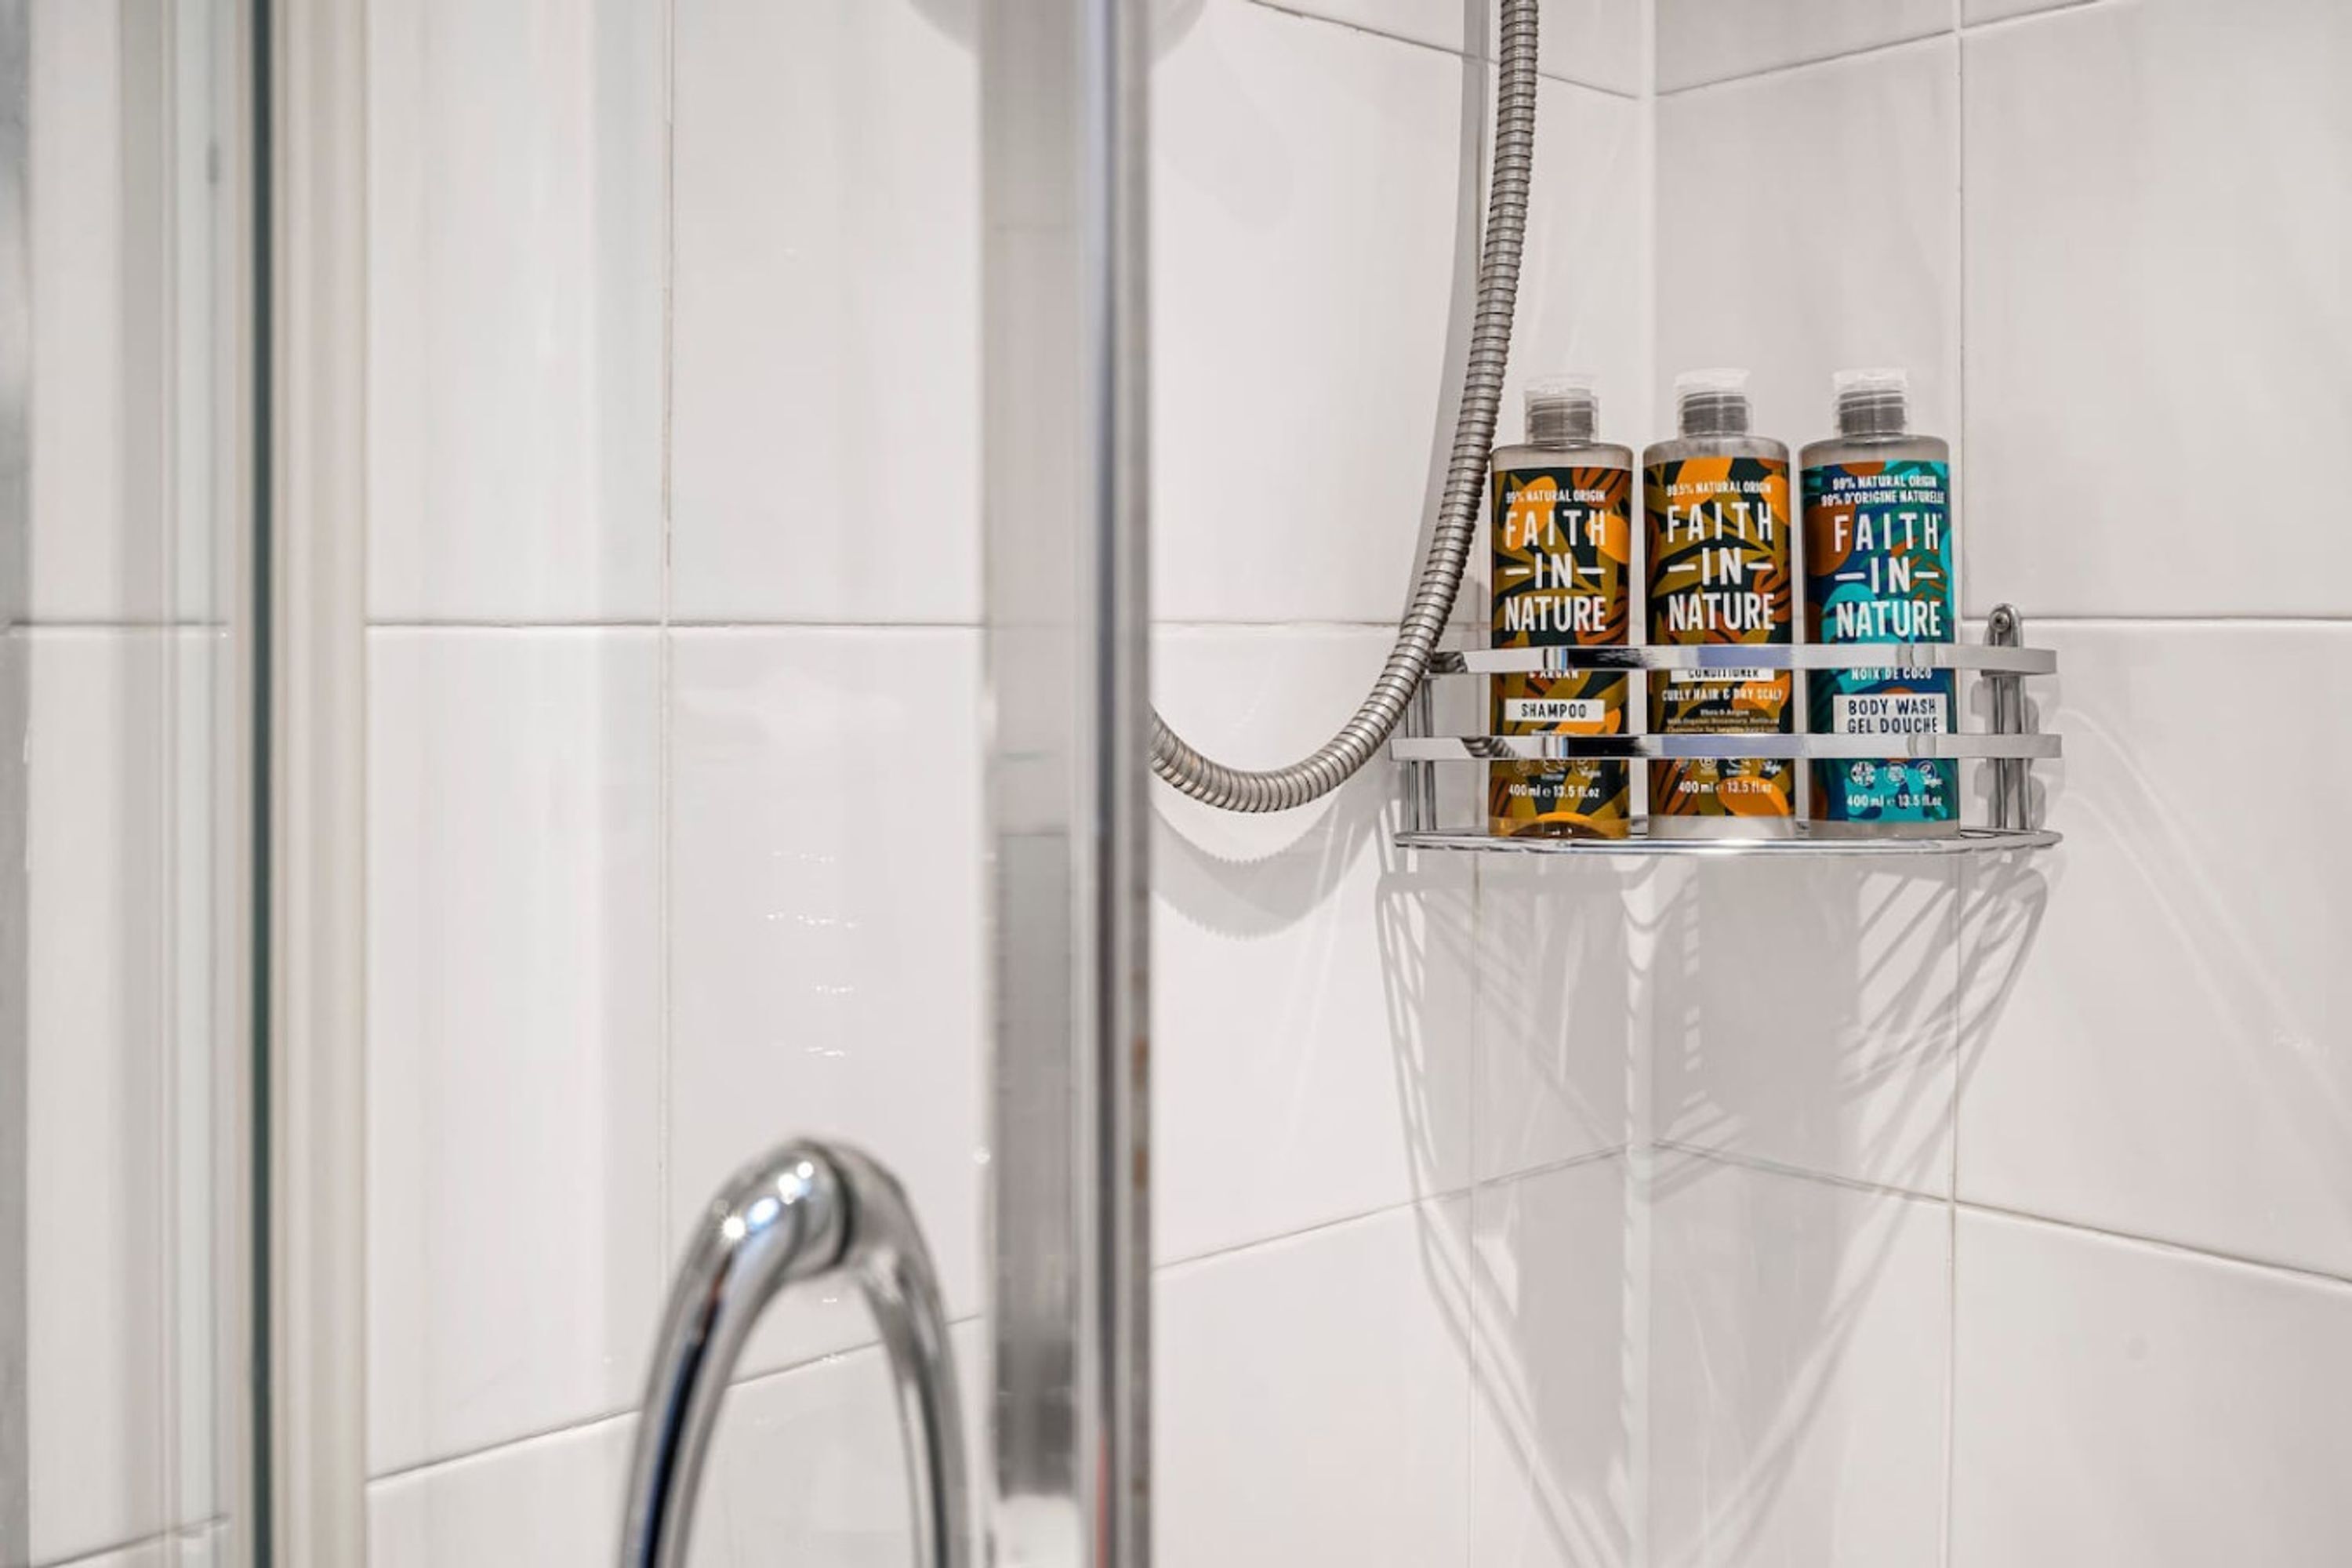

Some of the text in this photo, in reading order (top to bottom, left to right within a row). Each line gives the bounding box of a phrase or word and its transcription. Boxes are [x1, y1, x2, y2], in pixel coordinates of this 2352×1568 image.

[1695, 481, 1742, 495] NATURAL
[1743, 480, 1773, 494] ORIGIN
[1857, 475, 1907, 488] NATURAL
[1908, 474, 1937, 488] ORIGIN
[1526, 488, 1573, 503] NATURAL
[1573, 489, 1606, 503] ORIGIN
[1844, 491, 1898, 506] D'ORIGINE
[1505, 510, 1606, 548] FAITH
[1667, 502, 1773, 543] FAITH
[1834, 513, 1939, 552] FAITH
[1535, 552, 1572, 589] IN
[1701, 546, 1742, 586] IN
[1871, 557, 1911, 593] IN
[1504, 596, 1606, 632] NATURE
[1668, 591, 1777, 631] NATURE
[1836, 601, 1942, 638] NATURE
[1851, 668, 1933, 681] NOIX DE COCO
[1661, 689, 1690, 702] CURLY
[1693, 688, 1720, 701] HAIR
[1733, 688, 1755, 700] DRY
[1757, 688, 1783, 701] SCALP
[1521, 703, 1587, 718] SHAMPOO
[1848, 698, 1937, 715] BODY WASH
[1847, 717, 1938, 734] GEL DOUCHE
[1508, 784, 1527, 797] 400
[1528, 784, 1541, 797] ml
[1553, 786, 1575, 798] 13.5
[1679, 781, 1699, 793] 400
[1700, 781, 1714, 793] ml
[1727, 781, 1750, 793] 13.5
[1847, 794, 1868, 807] 400
[1870, 794, 1885, 807] ml
[1897, 794, 1920, 808] 13.5
